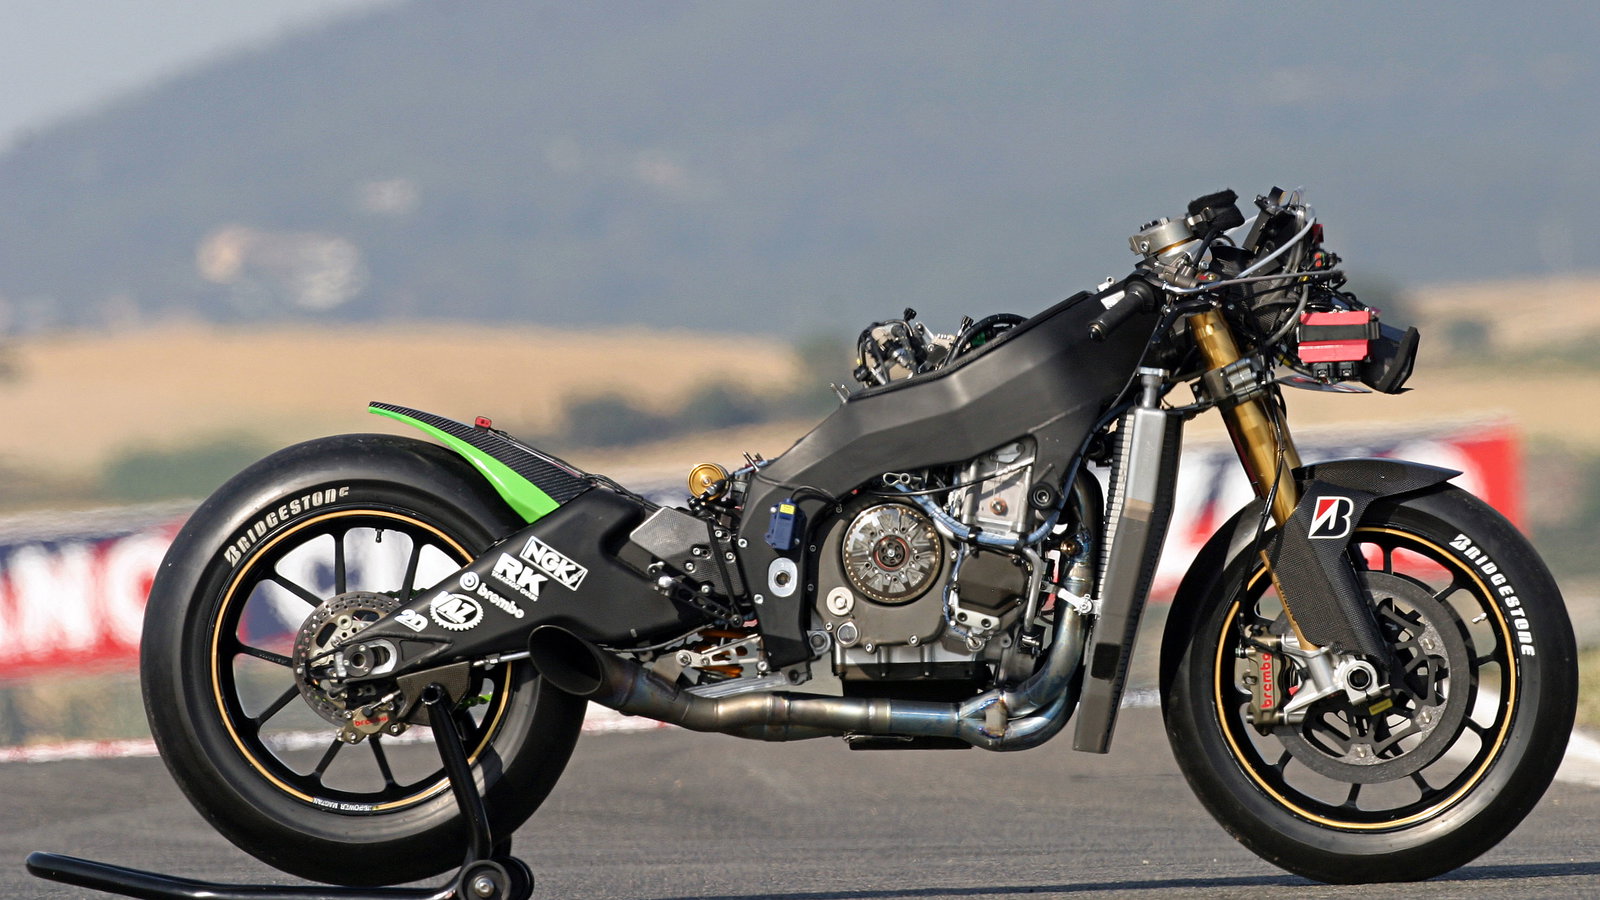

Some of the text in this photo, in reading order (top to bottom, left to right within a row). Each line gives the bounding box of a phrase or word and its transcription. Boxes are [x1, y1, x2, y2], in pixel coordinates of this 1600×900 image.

[493, 552, 548, 597] RK
[523, 539, 577, 584] NGK
[477, 583, 525, 619] brembo
[1449, 533, 1535, 656] BRIDGESTONE
[394, 609, 428, 632] 2D
[1260, 653, 1273, 708] brembo
